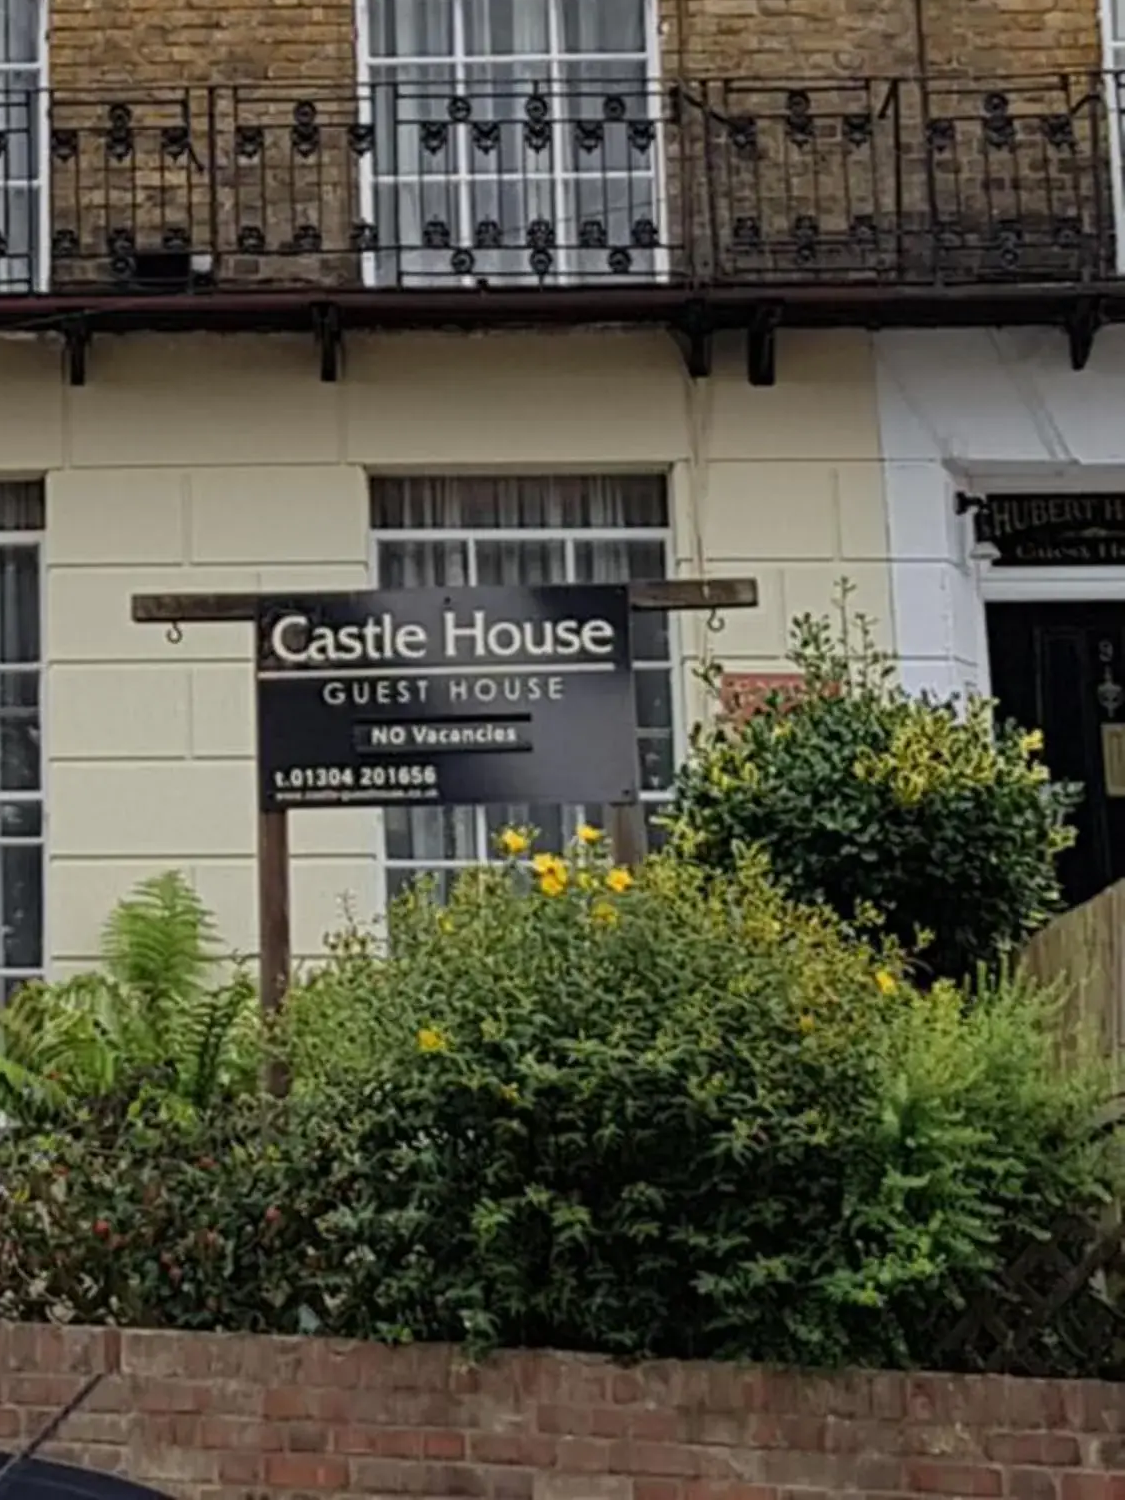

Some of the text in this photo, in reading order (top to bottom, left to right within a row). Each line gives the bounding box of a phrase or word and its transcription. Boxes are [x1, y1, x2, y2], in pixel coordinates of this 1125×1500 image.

[271, 609, 615, 662] Castle House
[323, 676, 565, 705] GUEST HOUSE
[371, 724, 518, 746] NO Vacancies
[274, 765, 437, 788] t.01304 201656
